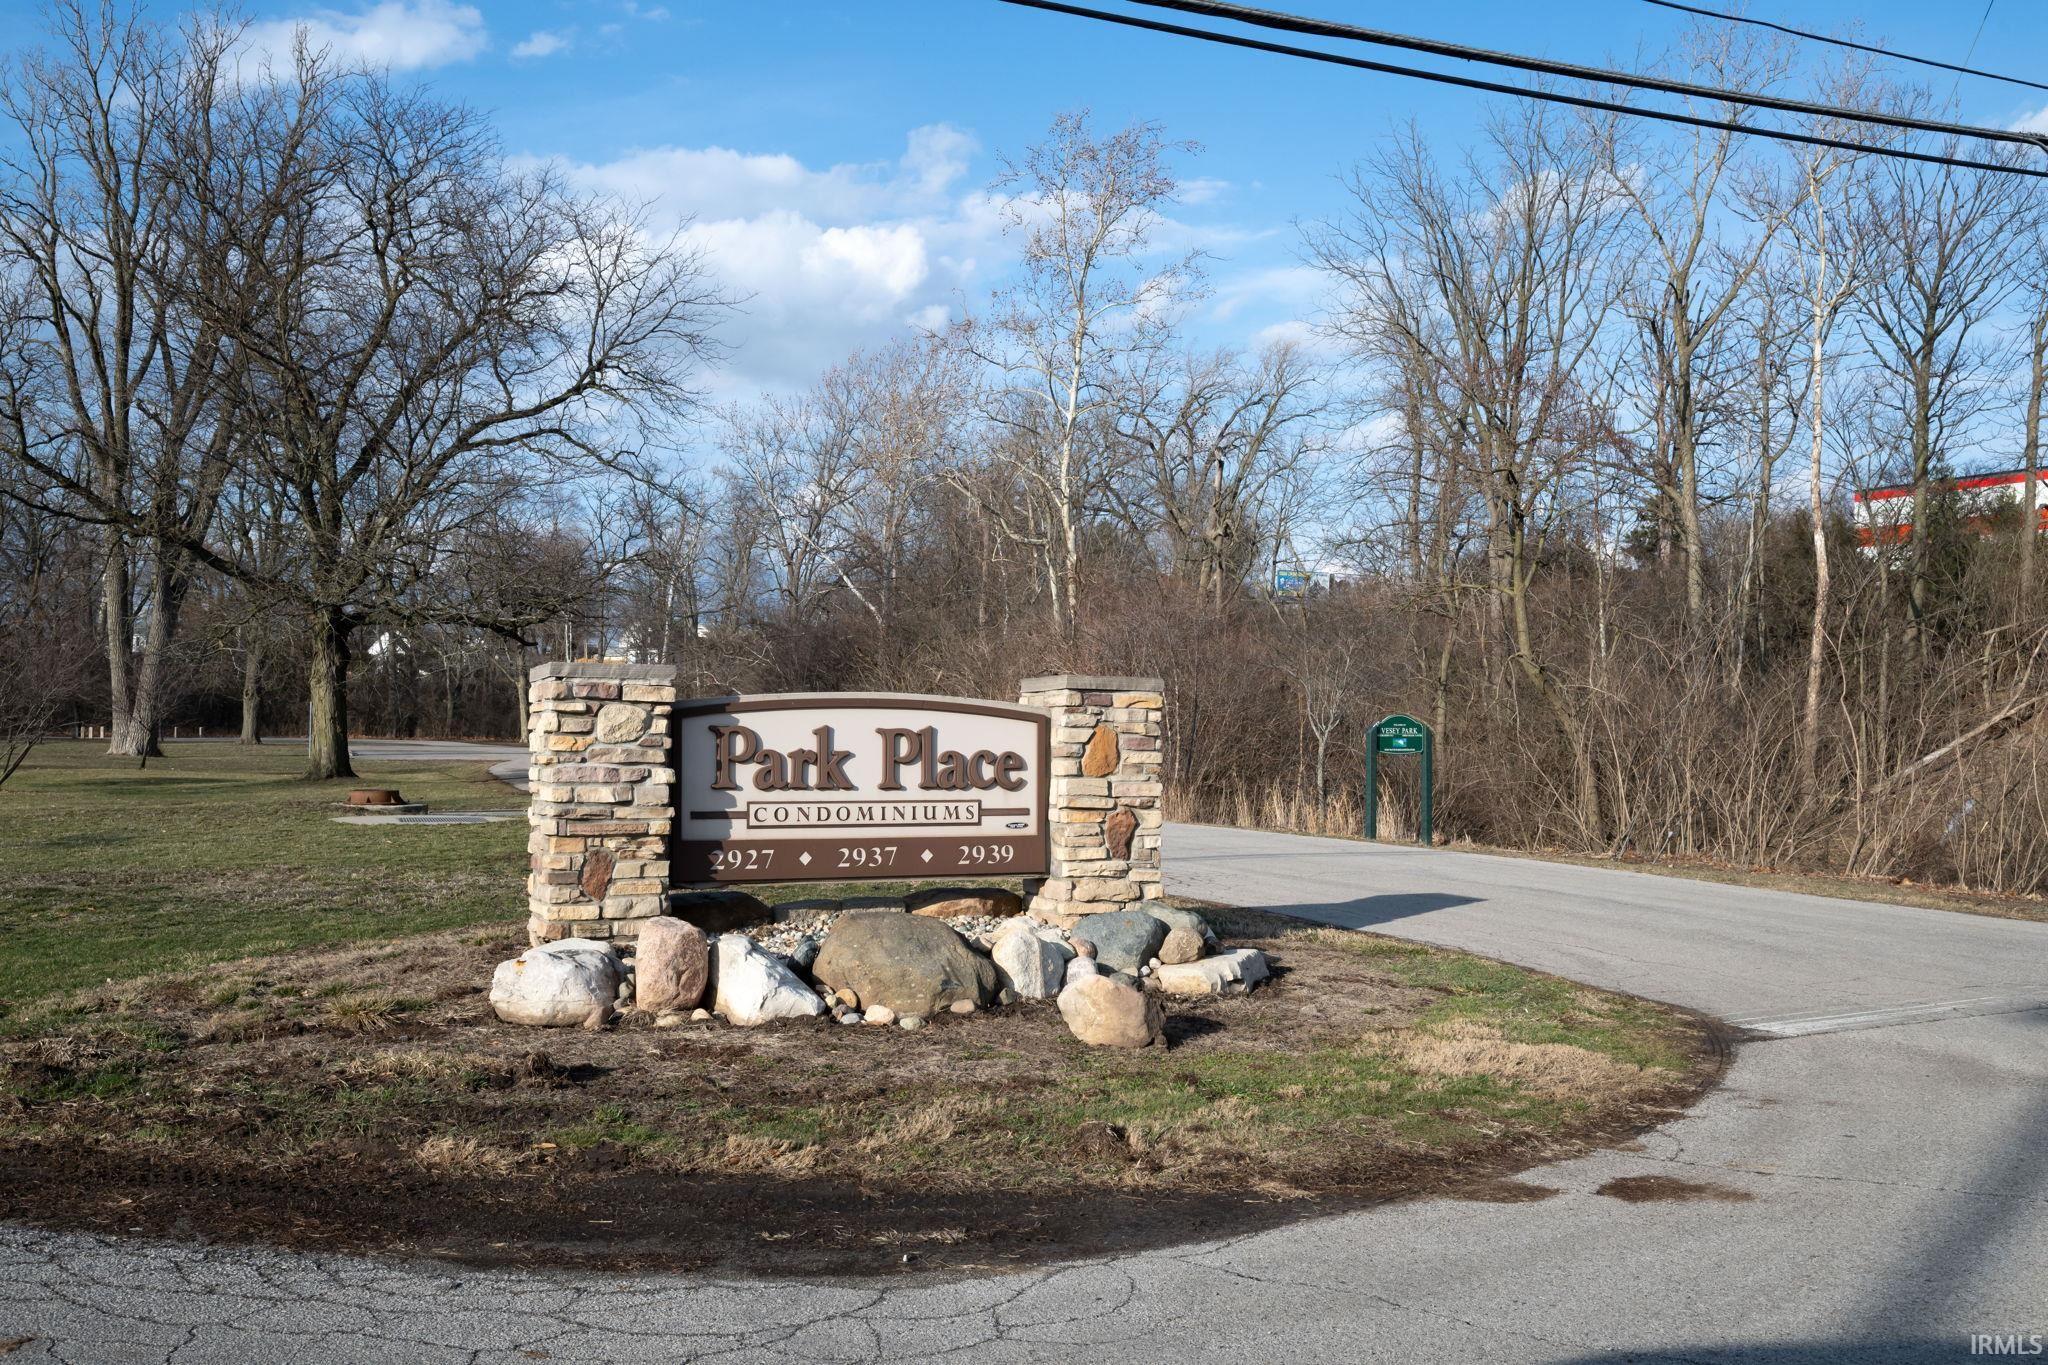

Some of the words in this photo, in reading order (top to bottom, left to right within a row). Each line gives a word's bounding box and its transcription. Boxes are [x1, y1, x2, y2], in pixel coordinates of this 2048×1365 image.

[708, 724, 856, 790] Park
[875, 725, 1027, 791] Place
[753, 805, 975, 823] CONDOMINIUMS
[708, 849, 775, 870] 2927
[837, 847, 898, 868] 2937
[957, 844, 1014, 865] 2939
